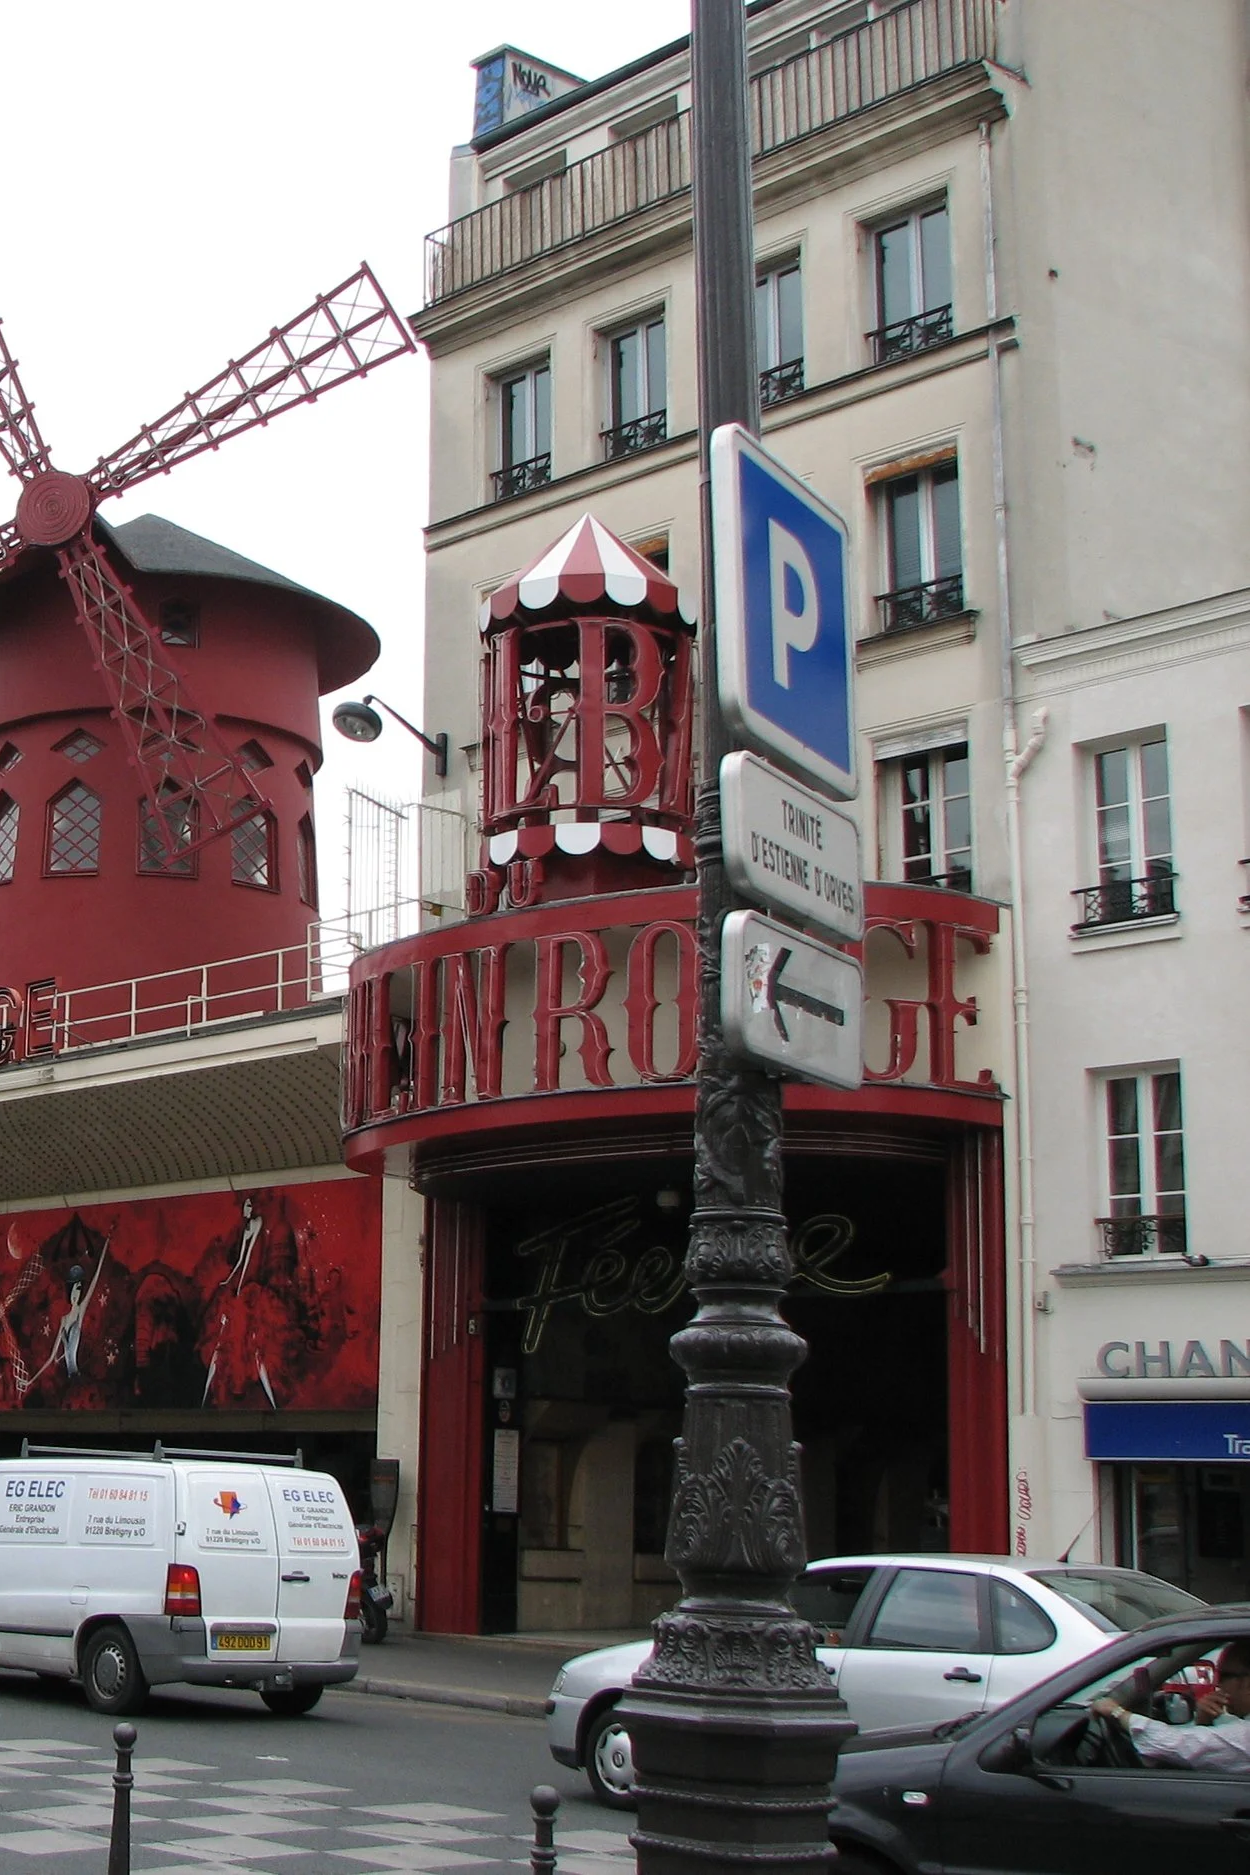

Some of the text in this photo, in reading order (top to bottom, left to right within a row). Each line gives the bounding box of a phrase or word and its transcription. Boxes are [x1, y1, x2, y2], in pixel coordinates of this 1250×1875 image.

[768, 517, 819, 690] P
[781, 799, 823, 851] TRINITÉ
[751, 831, 854, 914] D'ESTIENNE D'ORVES
[466, 859, 544, 917] DU
[532, 917, 998, 1095] ROGE
[515, 1197, 892, 1353] Féee
[6, 1480, 66, 1498] EG ELEC
[100, 1490, 108, 1500] 01
[140, 1491, 148, 1500] 15
[283, 1490, 335, 1503] EG ELEC
[9, 1504, 56, 1512] ERIC GRANDON
[16, 1515, 45, 1524] Entreprise
[105, 1515, 113, 1524] du
[115, 1515, 145, 1524] Limousin
[232, 1528, 258, 1536] Limousin
[304, 1537, 311, 1546] 01
[219, 1636, 236, 1648] 492
[256, 1636, 268, 1648] 91
